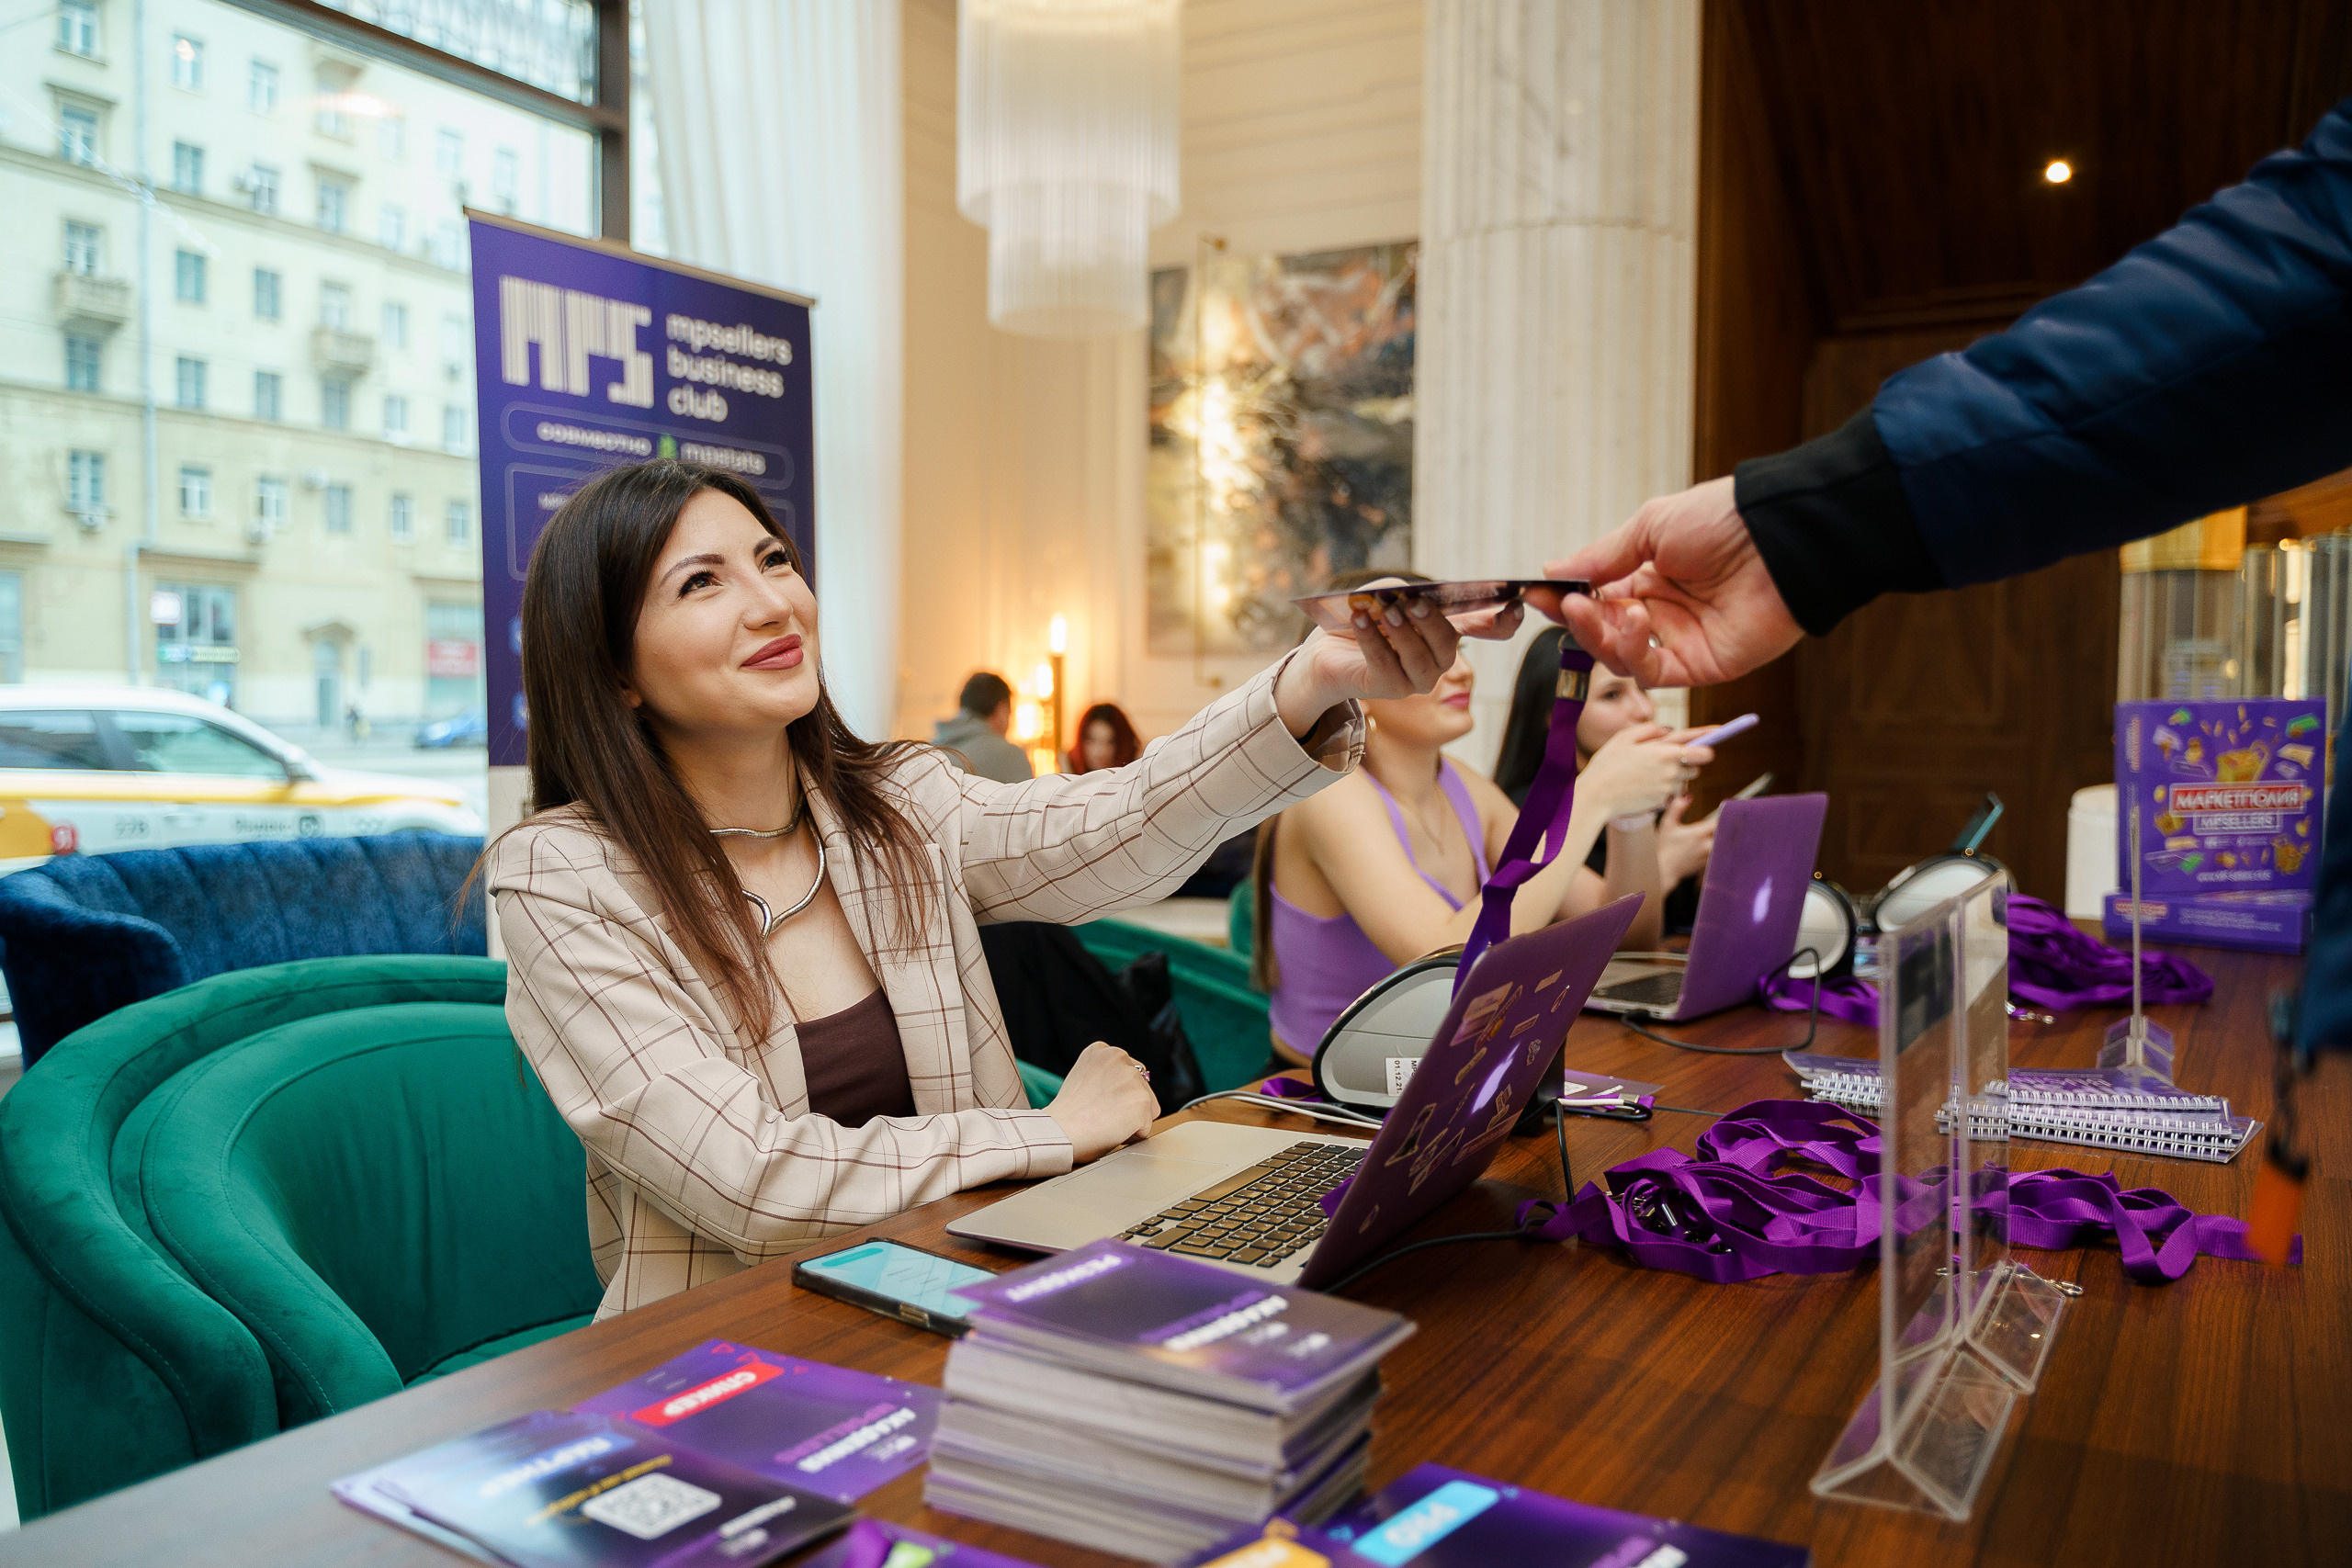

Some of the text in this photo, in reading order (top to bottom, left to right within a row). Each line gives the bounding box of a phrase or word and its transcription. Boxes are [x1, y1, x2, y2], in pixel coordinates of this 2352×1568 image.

[667, 314, 792, 366] mpsellers
[667, 344, 785, 398] business
[667, 384, 728, 422] club
